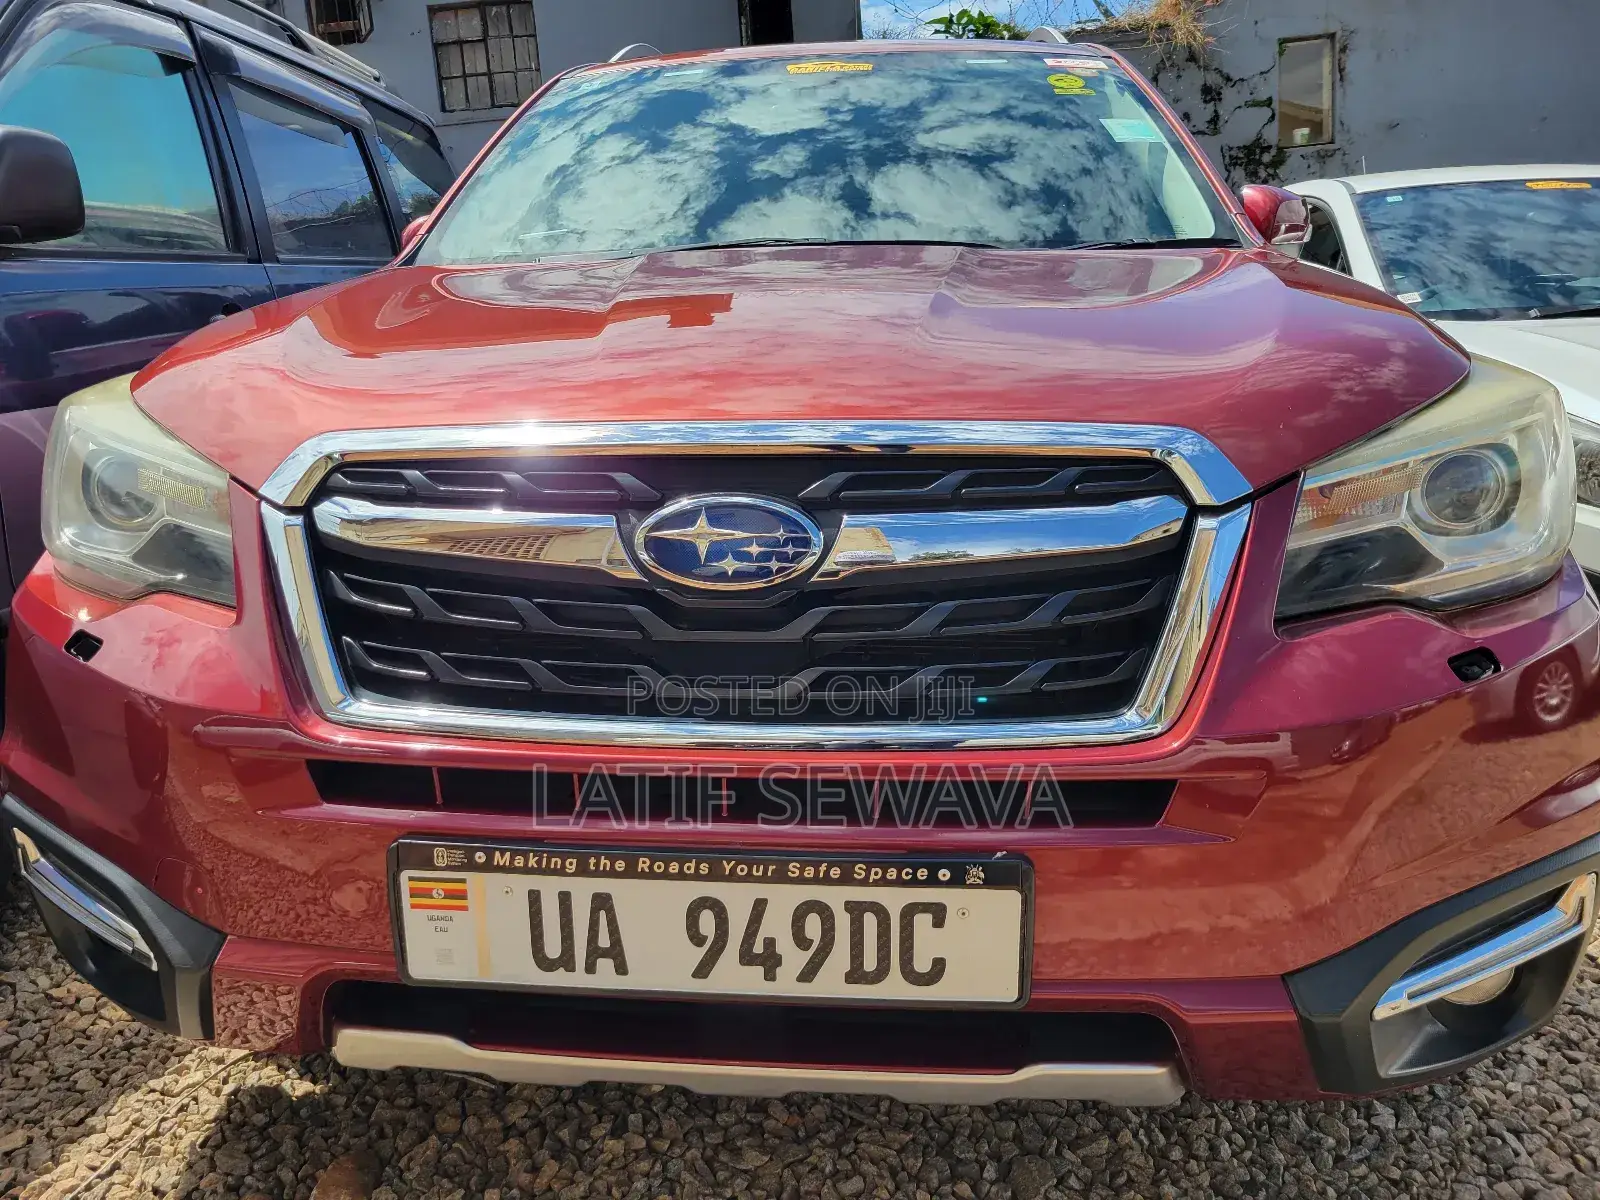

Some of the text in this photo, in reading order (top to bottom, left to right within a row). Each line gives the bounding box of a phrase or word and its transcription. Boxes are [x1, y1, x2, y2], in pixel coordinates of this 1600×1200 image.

[493, 850, 929, 882] Making the Roads Your Safe Space
[528, 888, 948, 987] UA 949DC
